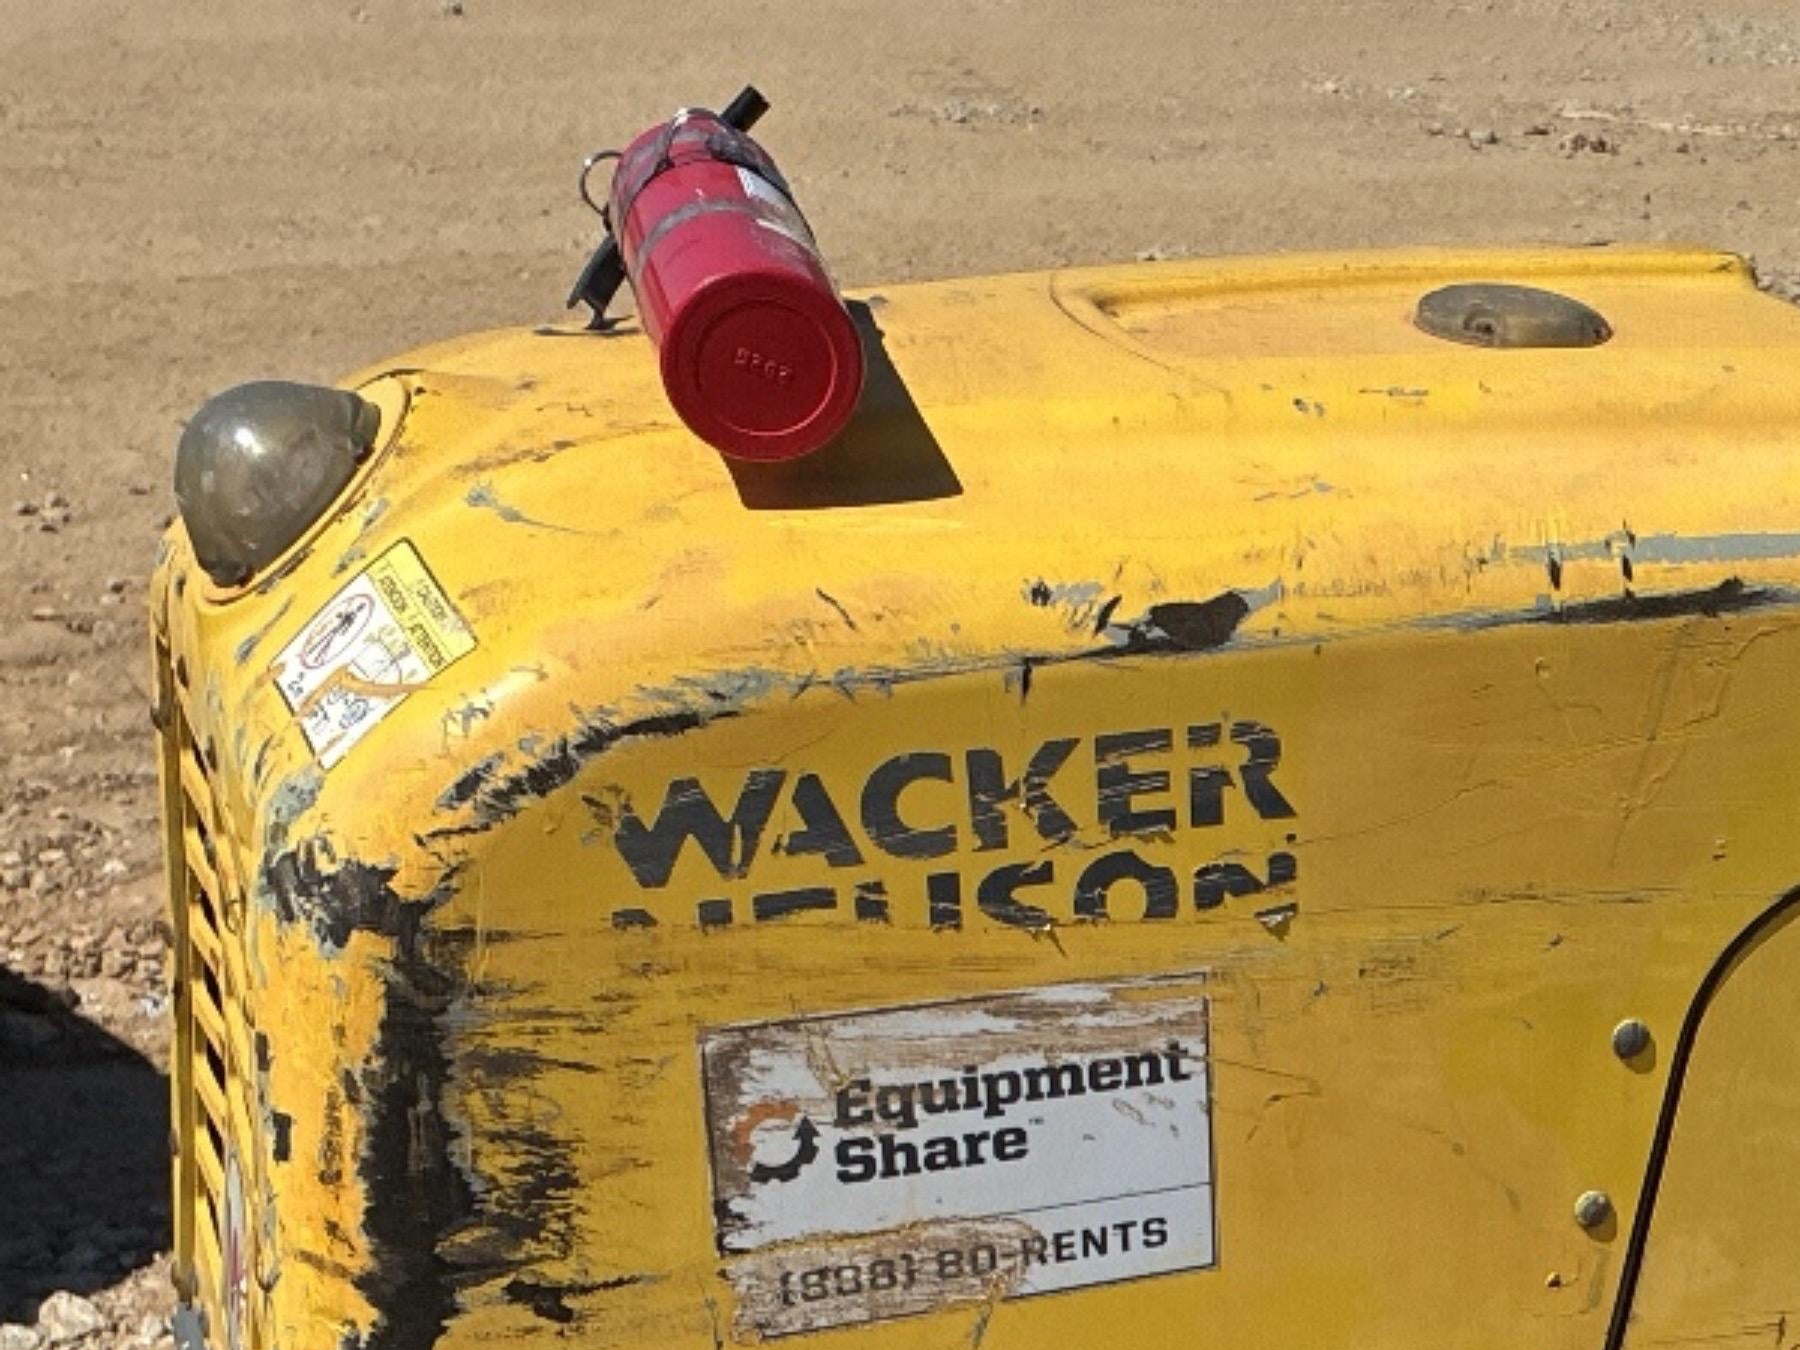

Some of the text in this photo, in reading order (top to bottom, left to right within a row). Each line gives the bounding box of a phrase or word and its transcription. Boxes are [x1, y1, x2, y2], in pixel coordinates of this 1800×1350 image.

[612, 720, 1297, 889] WACKER
[611, 850, 1298, 931] SON
[833, 1040, 1191, 1129] Equipment
[834, 1126, 1029, 1184] Share
[936, 1217, 1169, 1279] 80-RENTS
